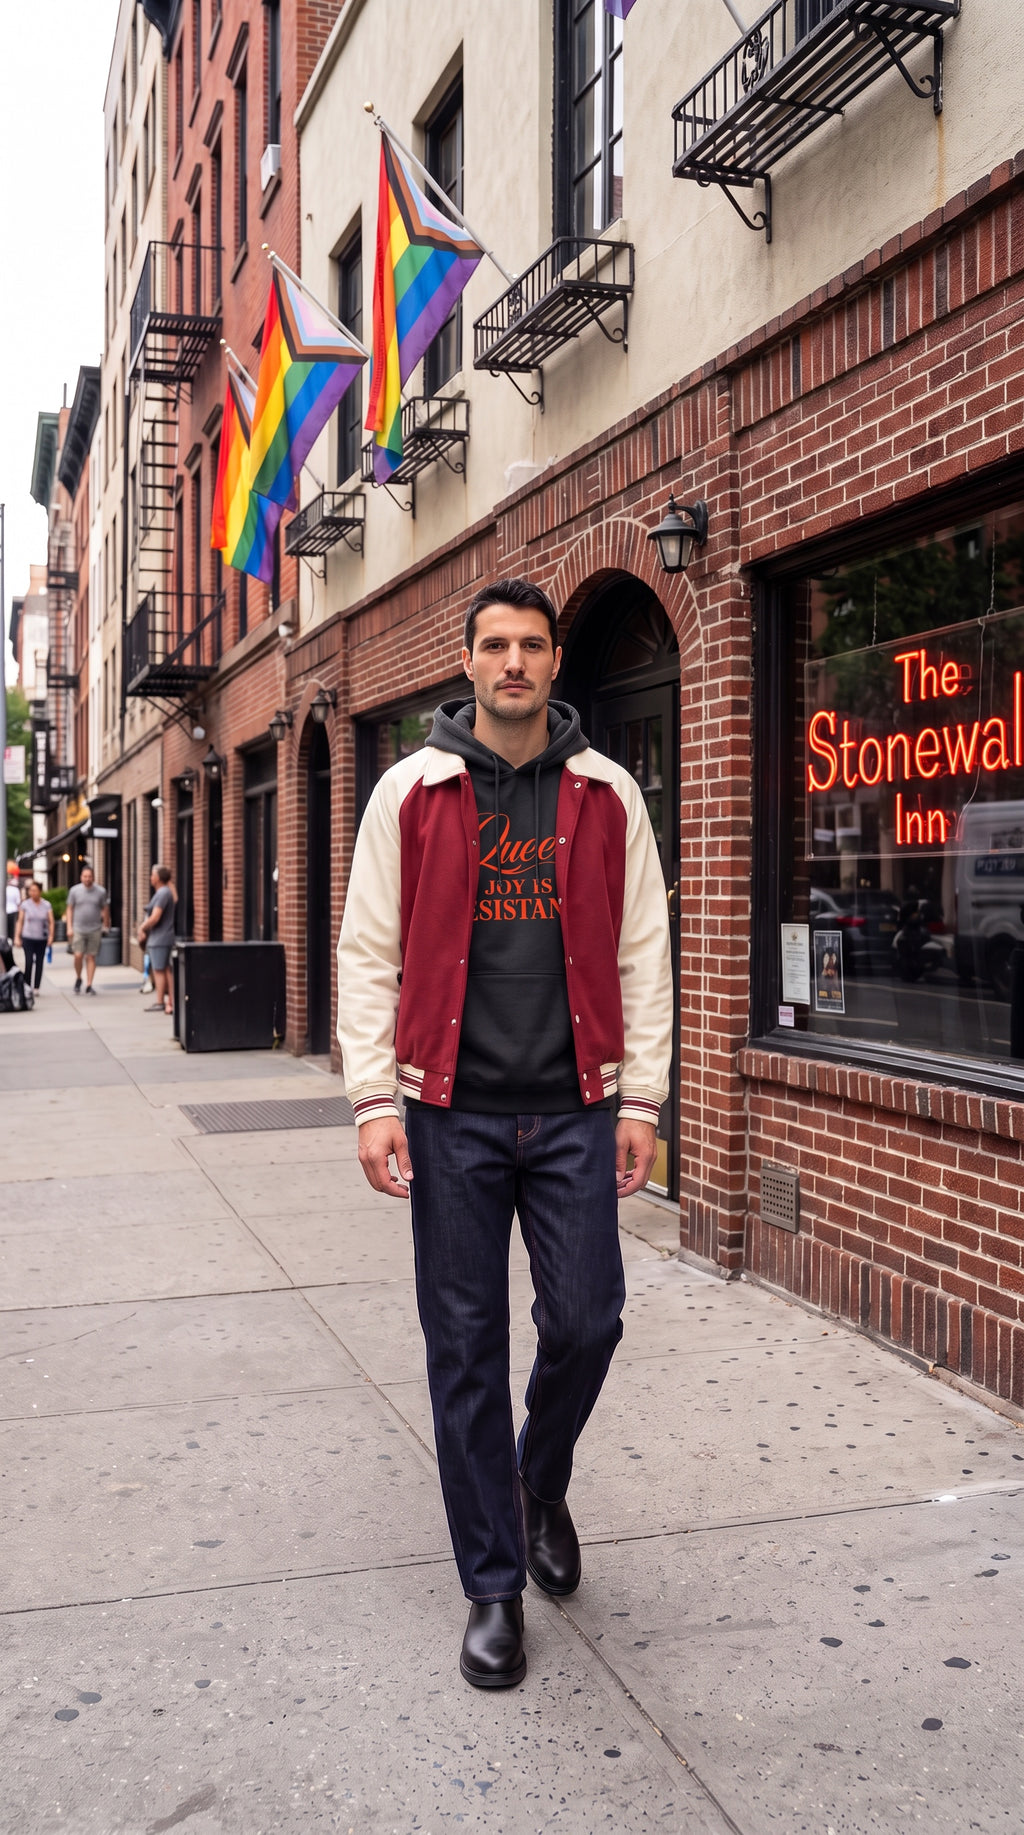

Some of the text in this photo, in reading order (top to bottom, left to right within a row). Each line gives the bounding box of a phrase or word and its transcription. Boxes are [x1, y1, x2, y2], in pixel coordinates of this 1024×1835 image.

[894, 649, 959, 703] The
[807, 671, 1024, 792] Stonewal
[477, 812, 556, 875] Quee
[896, 792, 947, 845] Inn
[472, 897, 561, 921] SISTAN
[484, 878, 553, 896] JOY IS
